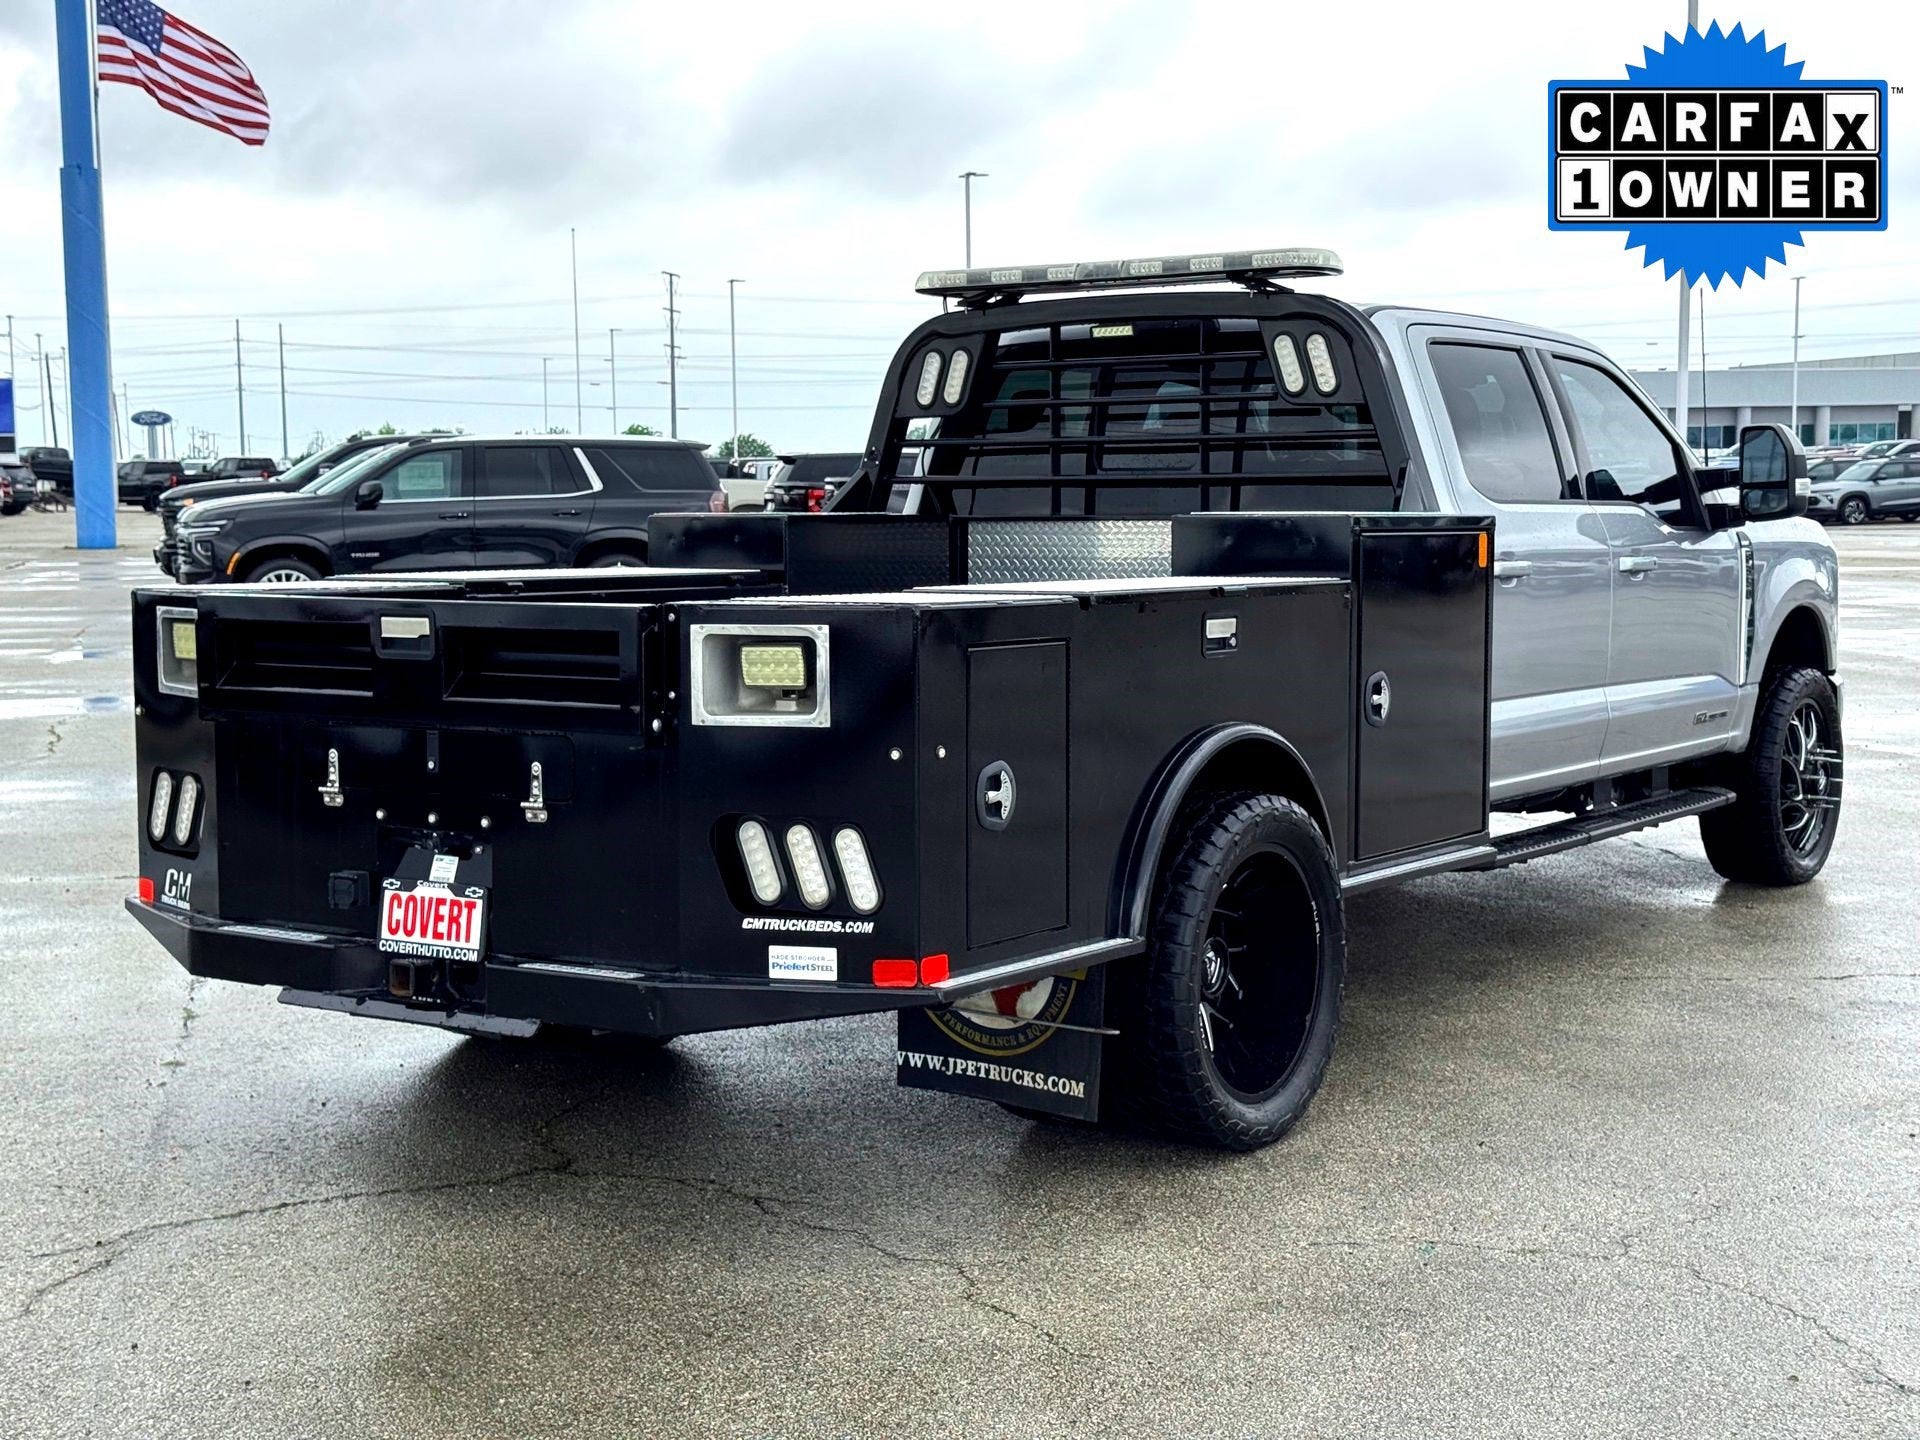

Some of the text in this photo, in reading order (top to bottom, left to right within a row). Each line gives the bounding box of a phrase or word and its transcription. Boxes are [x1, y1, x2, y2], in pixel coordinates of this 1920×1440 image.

[164, 868, 192, 902] CM
[417, 880, 448, 889] Covert
[387, 893, 477, 943] COVERT
[741, 917, 875, 934] CMTRUCKBEDS.COM
[379, 940, 478, 962] COVERTHUTTO.COM
[942, 1012, 1018, 1047] PERFORMANCE
[1025, 982, 1069, 1040] EQUPMENT
